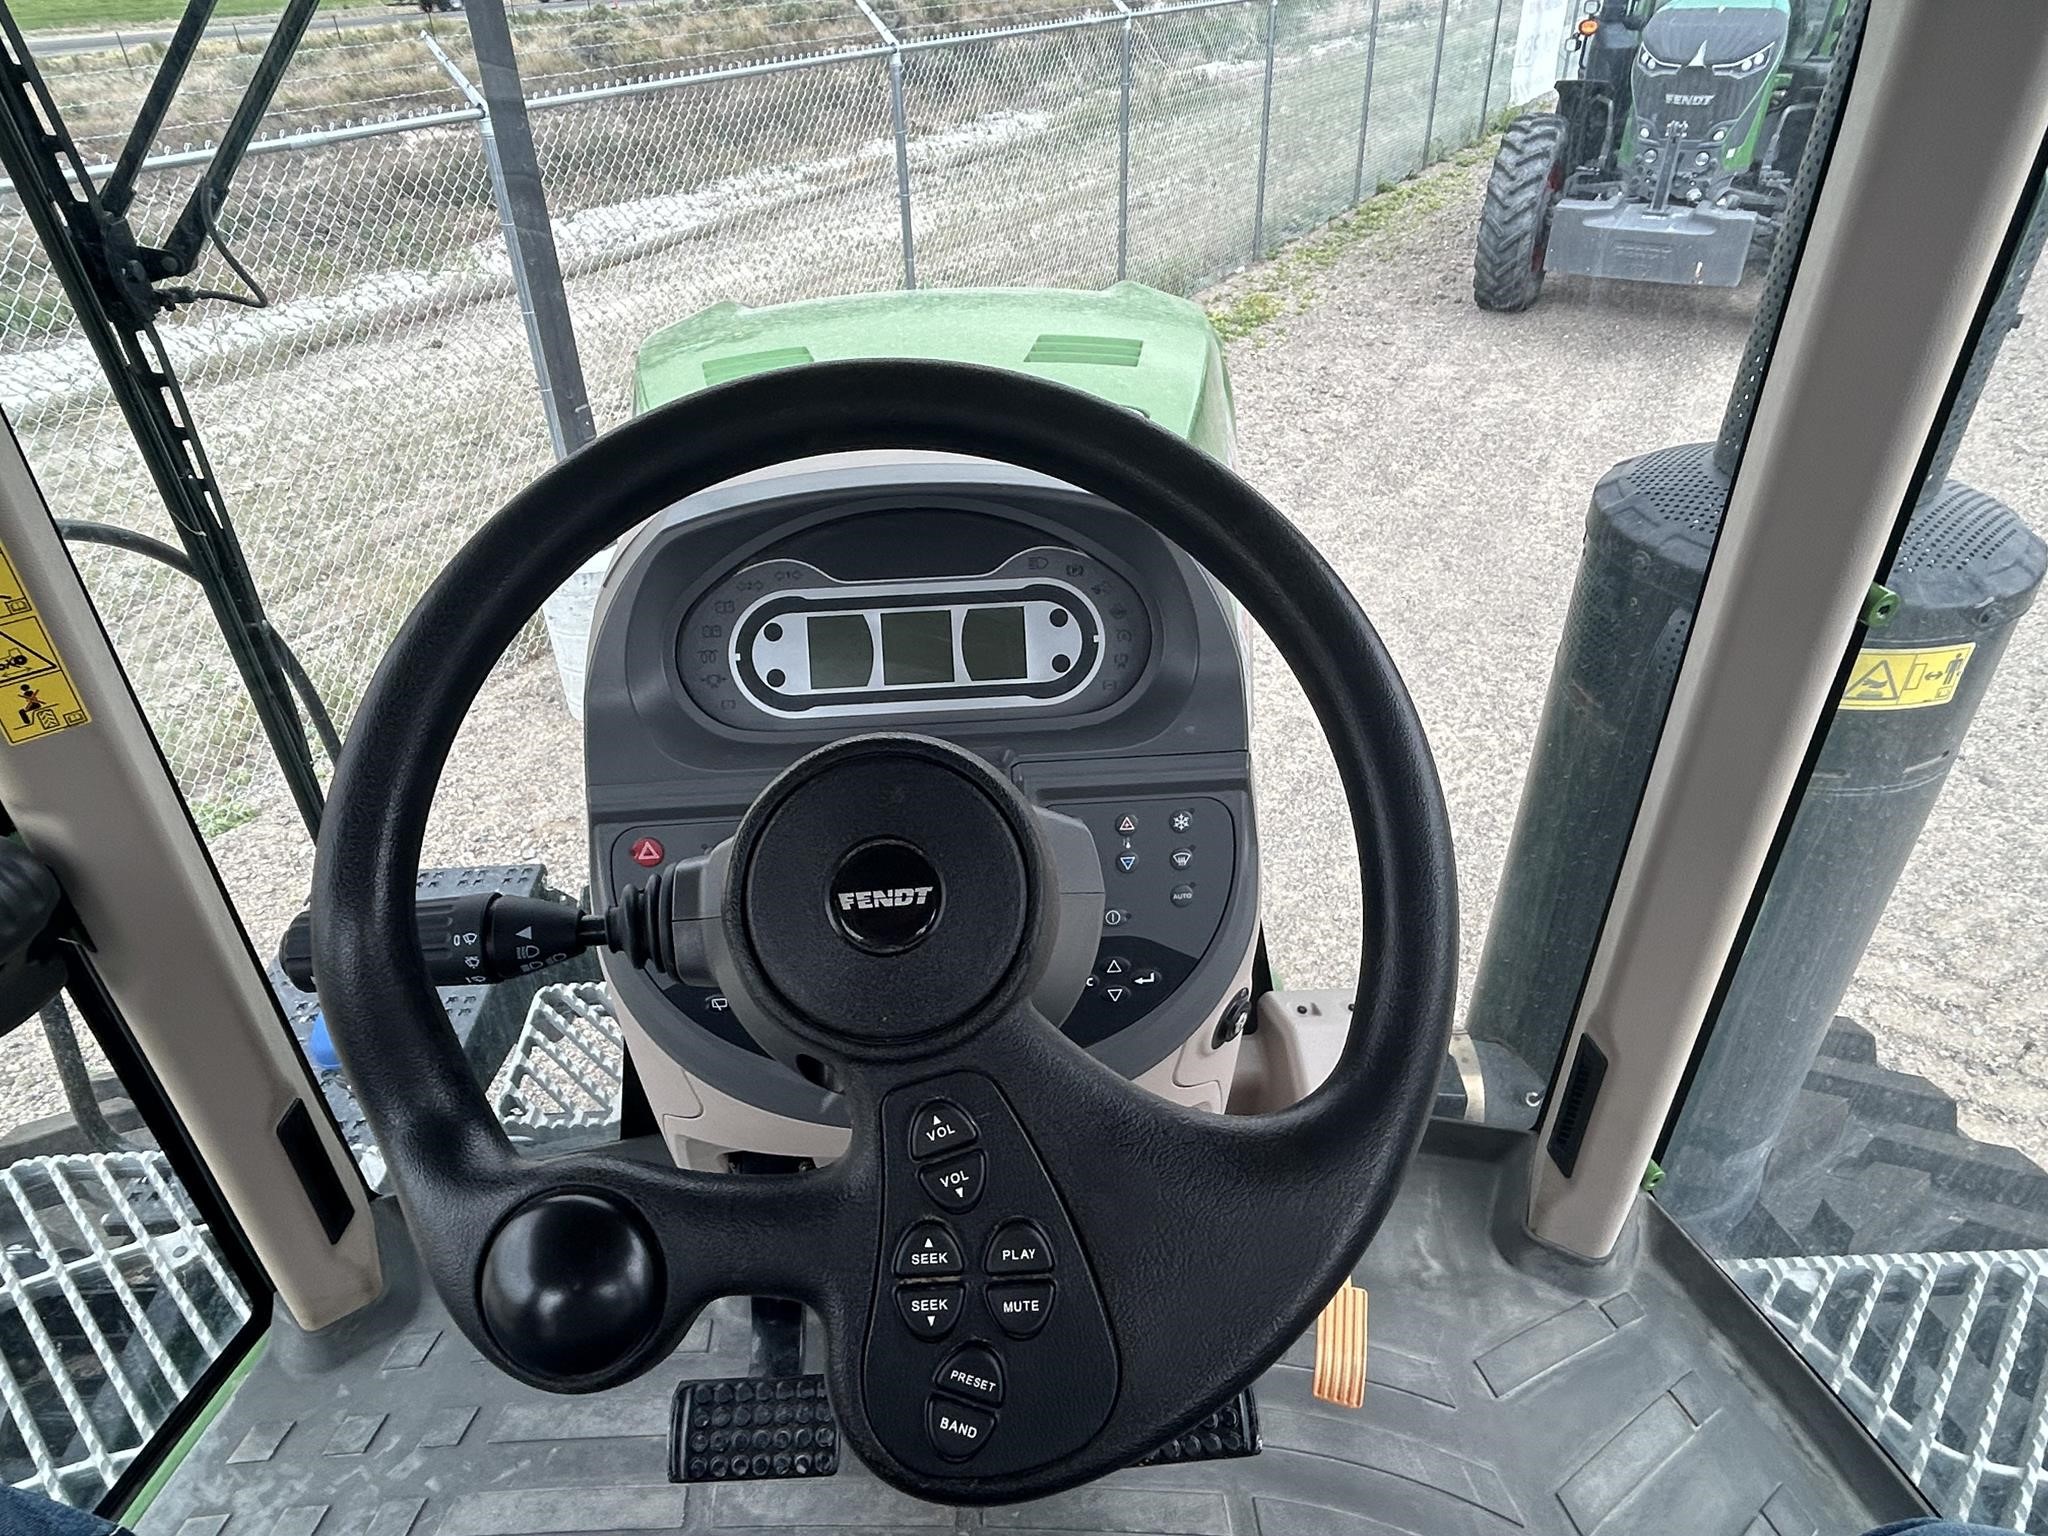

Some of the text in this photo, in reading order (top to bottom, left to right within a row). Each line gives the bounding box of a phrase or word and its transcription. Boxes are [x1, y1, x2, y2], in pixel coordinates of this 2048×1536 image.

[1665, 93, 1716, 106] FENDT
[838, 886, 934, 911] FENDT
[1173, 892, 1192, 900] AUTO
[1086, 977, 1093, 987] C
[926, 1123, 956, 1142] VOL
[939, 1170, 970, 1188] VOL
[911, 1251, 948, 1266] SEEK
[1002, 1248, 1036, 1261] PLAY
[911, 1298, 948, 1312] SEEK
[1003, 1299, 1040, 1313] MUTE
[950, 1370, 997, 1393] PRESET
[939, 1416, 978, 1439] BAND
